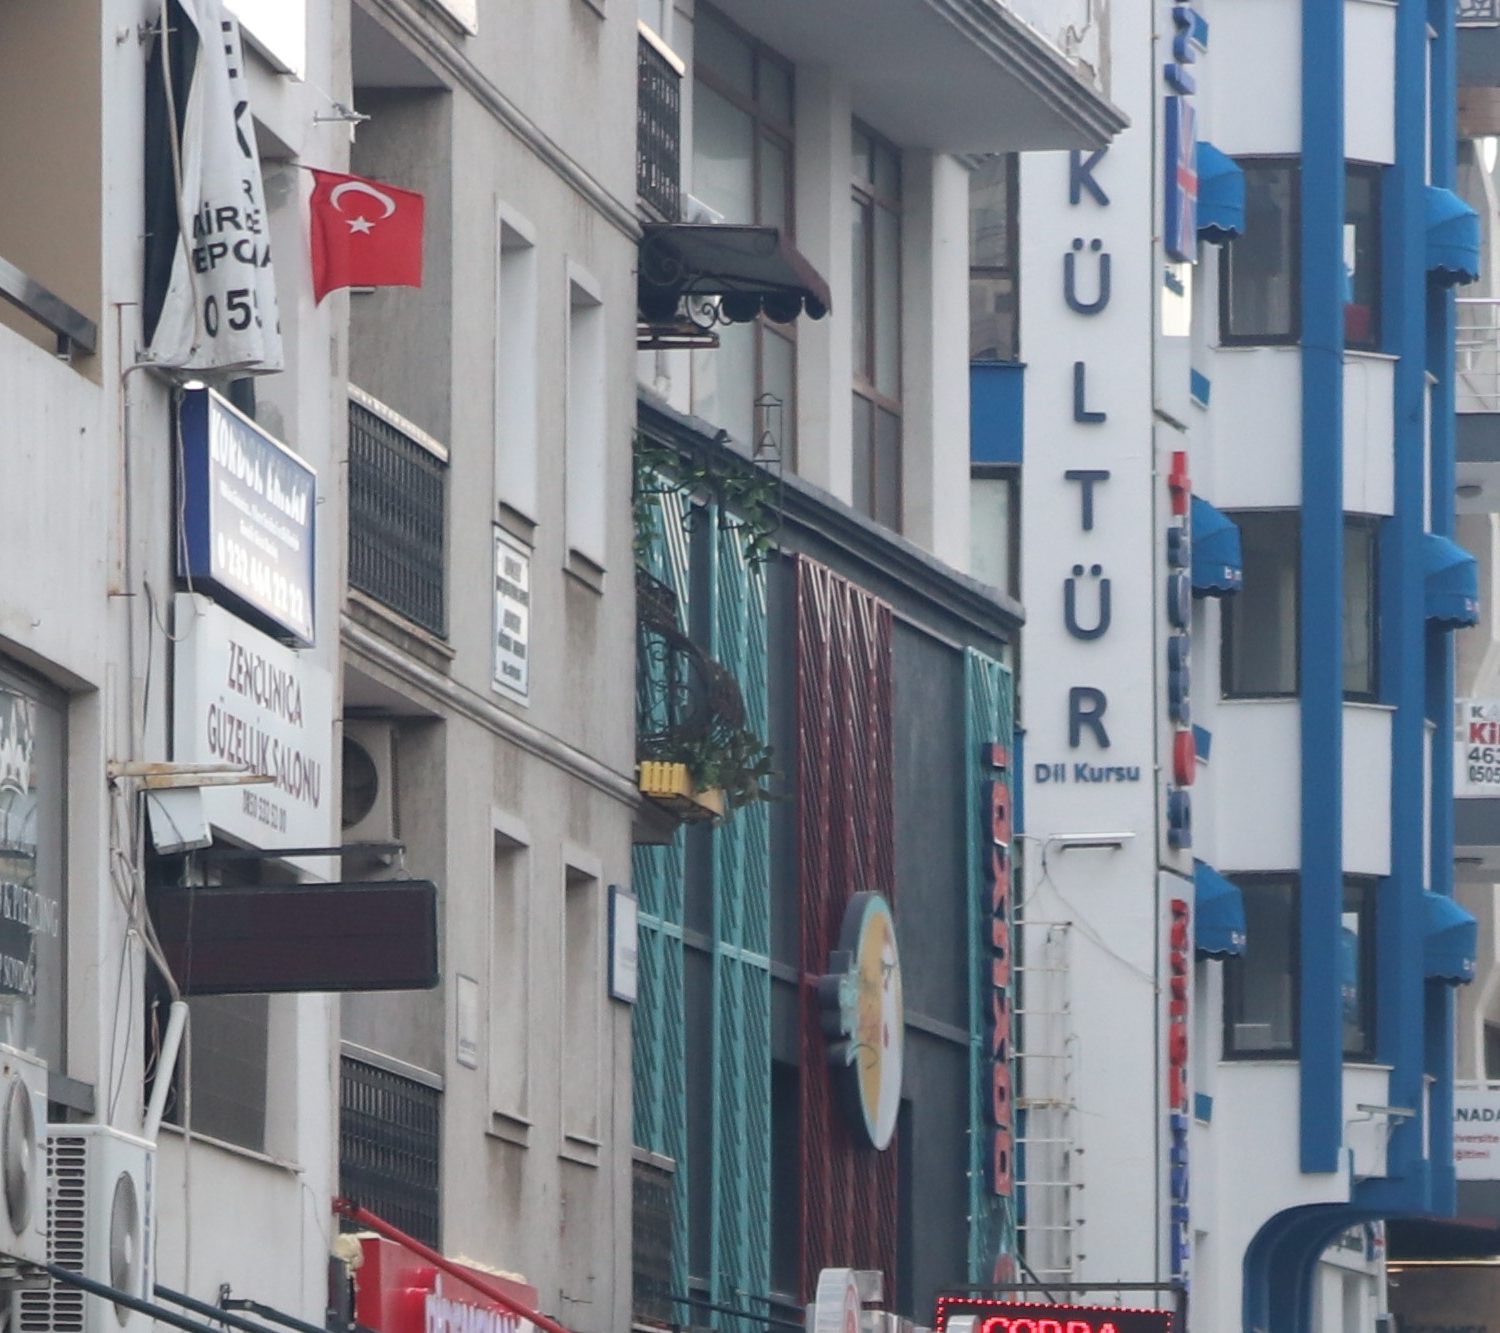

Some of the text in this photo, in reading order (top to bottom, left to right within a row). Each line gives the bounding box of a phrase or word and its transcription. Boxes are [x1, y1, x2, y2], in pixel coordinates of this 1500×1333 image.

[272, 738, 321, 809] SALONU
[1034, 762, 1141, 784] Dil Kursu
